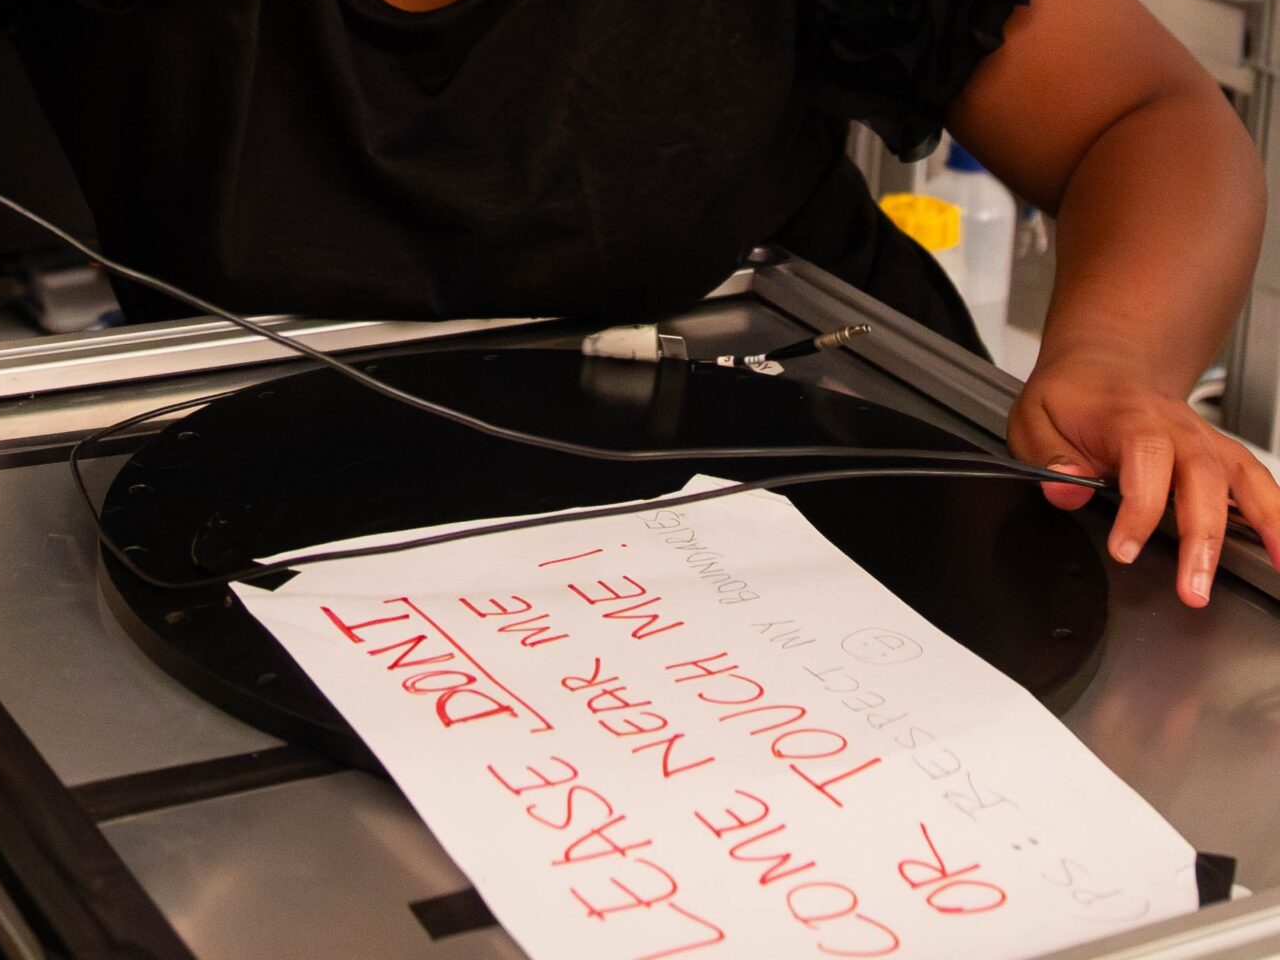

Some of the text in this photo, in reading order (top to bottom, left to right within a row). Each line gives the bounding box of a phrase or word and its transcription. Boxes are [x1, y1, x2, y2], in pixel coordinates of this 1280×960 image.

[751, 619, 817, 649] MY
[458, 595, 901, 958] COME NEAR ME
[665, 652, 883, 808] TOUCH
[802, 665, 1020, 823] RESPECT
[897, 822, 1008, 916] OR
